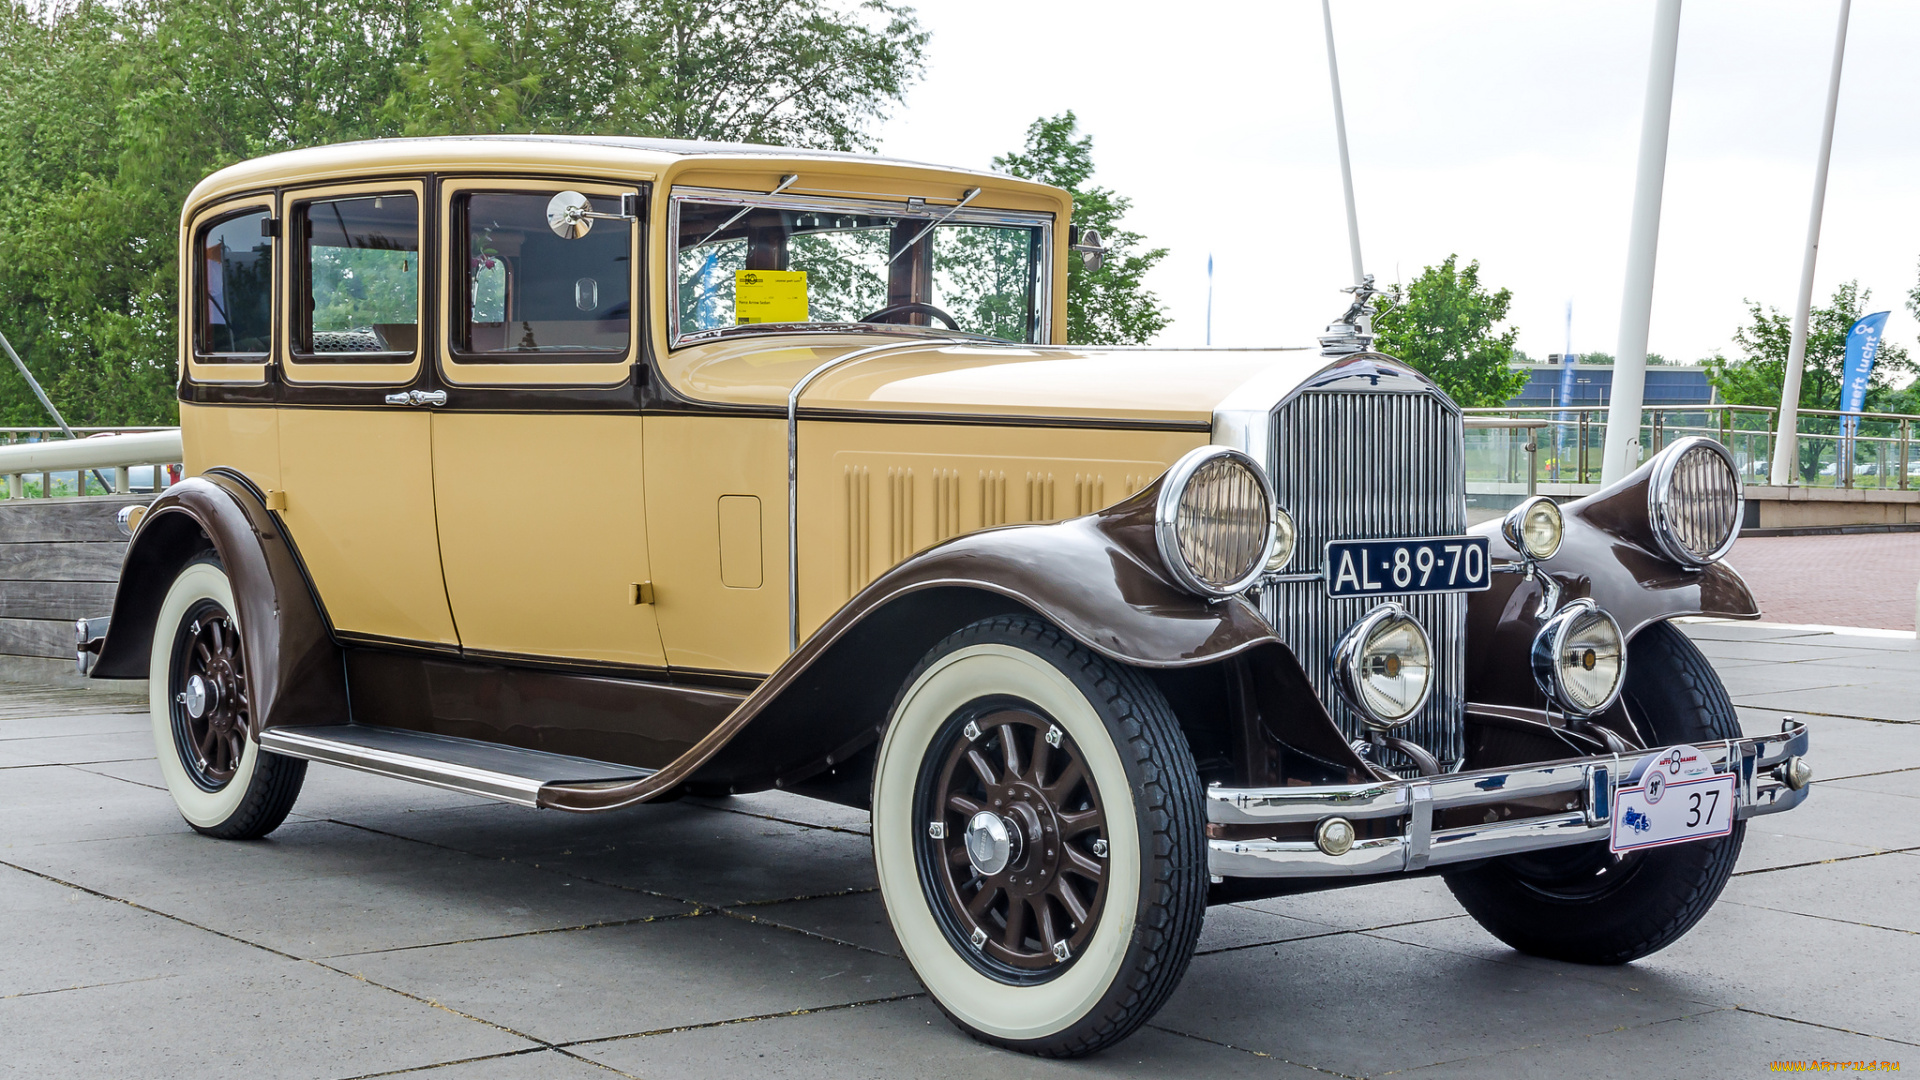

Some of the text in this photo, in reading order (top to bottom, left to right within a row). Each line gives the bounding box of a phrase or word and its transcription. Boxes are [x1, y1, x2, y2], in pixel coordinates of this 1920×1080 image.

[1856, 335, 1877, 373] lucht
[1334, 543, 1483, 592] AL-89-70
[1686, 789, 1720, 828] 37
